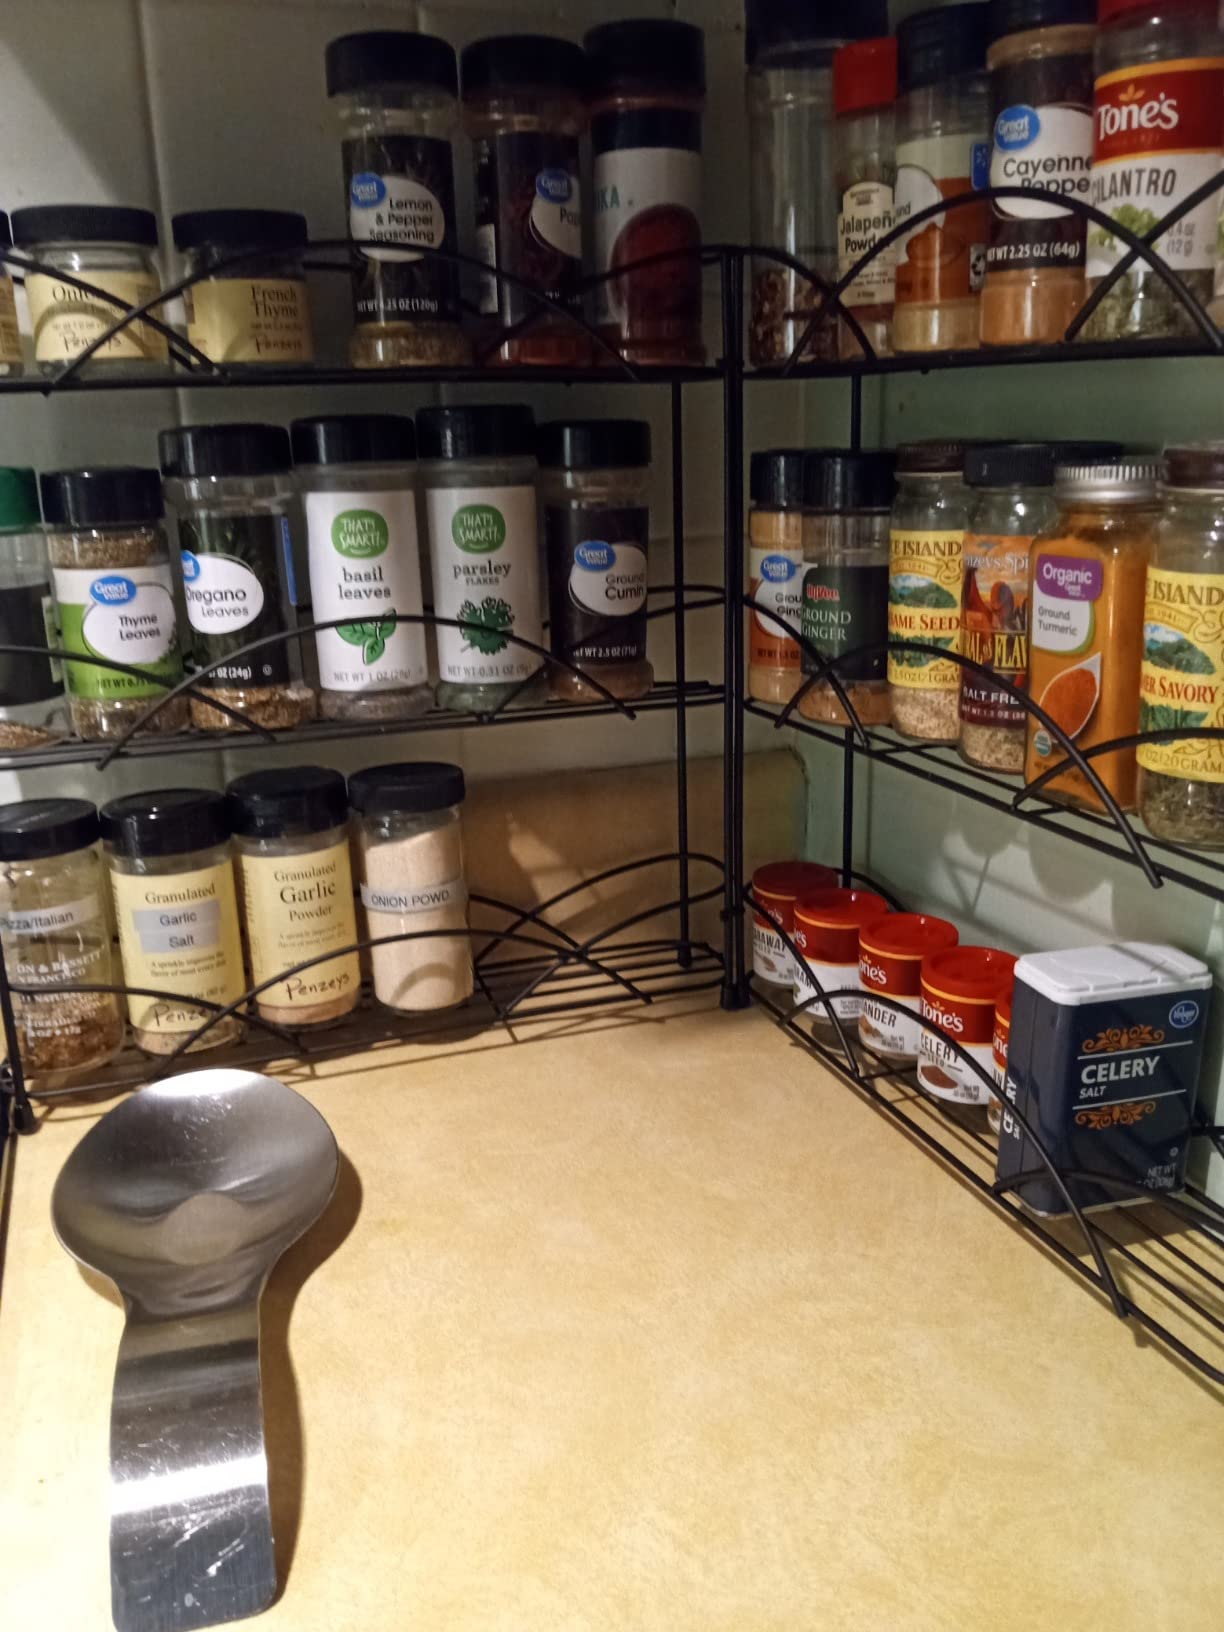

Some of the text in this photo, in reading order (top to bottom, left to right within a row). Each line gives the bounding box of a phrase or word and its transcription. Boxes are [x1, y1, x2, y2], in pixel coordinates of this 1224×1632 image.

[1098, 92, 1179, 141] Tone's
[388, 198, 433, 213] Lemon
[375, 210, 433, 229] & Pepper
[368, 227, 435, 245] Seasoning
[1009, 245, 1031, 260] 2.25
[1034, 244, 1049, 258] OZ
[1050, 241, 1081, 259] (64g)
[251, 284, 297, 303] French
[342, 565, 384, 583] basil
[452, 559, 512, 580] parsley
[1042, 561, 1093, 587] Organic
[338, 584, 391, 601] leaves
[119, 613, 158, 628] Thyme
[202, 605, 249, 619] Leaves
[1038, 605, 1071, 621] Ground
[119, 627, 161, 642] Leaves
[1038, 619, 1078, 637] Turmeric
[1159, 676, 1220, 704] SAVORY
[274, 862, 337, 883] Granulated
[144, 882, 216, 905] Granulated
[280, 879, 336, 905] Garlic
[371, 893, 408, 908] ONION
[159, 910, 198, 928] Garlic
[289, 904, 333, 922] Powder
[168, 934, 195, 949] Salt
[286, 972, 350, 1001] Penzeys
[921, 996, 965, 1034] Tone's
[1081, 1055, 1160, 1085] CELERY
[1079, 1085, 1107, 1100] SALT
